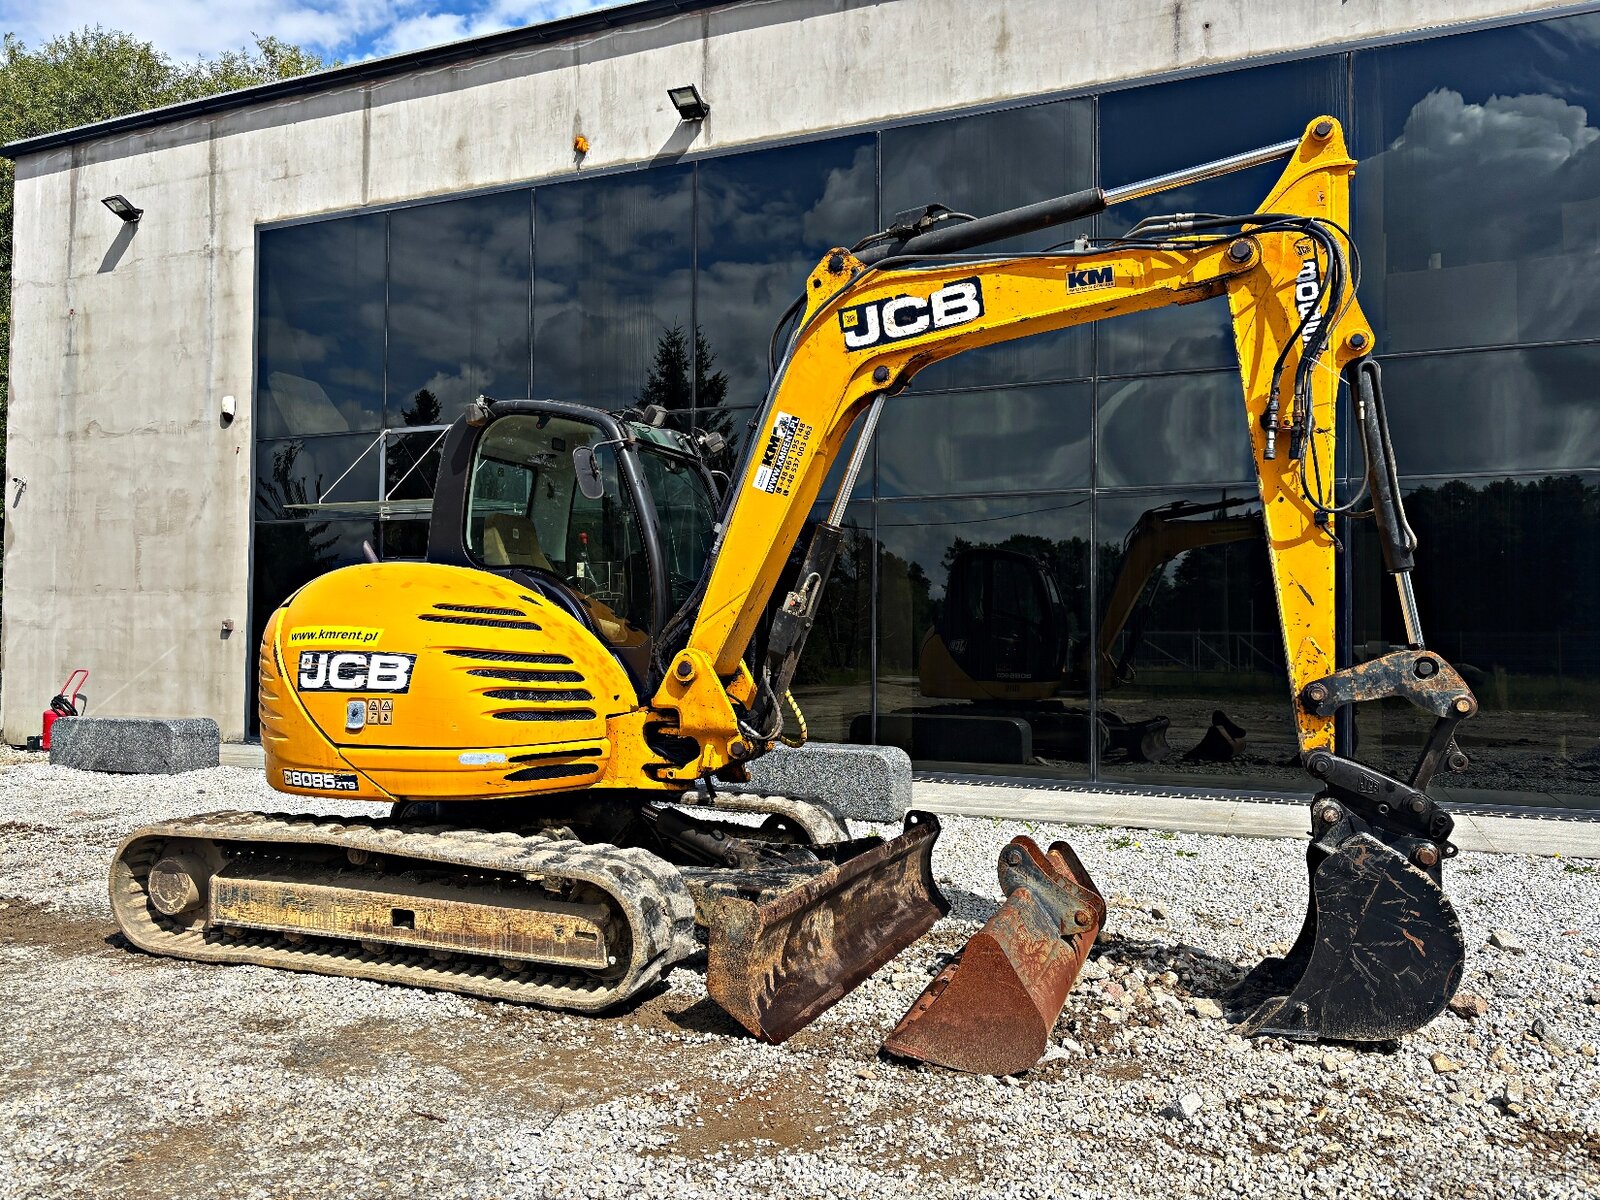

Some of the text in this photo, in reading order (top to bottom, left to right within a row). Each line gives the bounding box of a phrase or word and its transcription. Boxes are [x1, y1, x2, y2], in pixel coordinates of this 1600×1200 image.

[1068, 267, 1113, 288] KM
[845, 282, 980, 347] JCB
[762, 436, 780, 466] KM
[766, 417, 799, 493] WWW.KMRENT.PL
[291, 629, 378, 643] www.kmrent.pl
[300, 653, 411, 690] JCB
